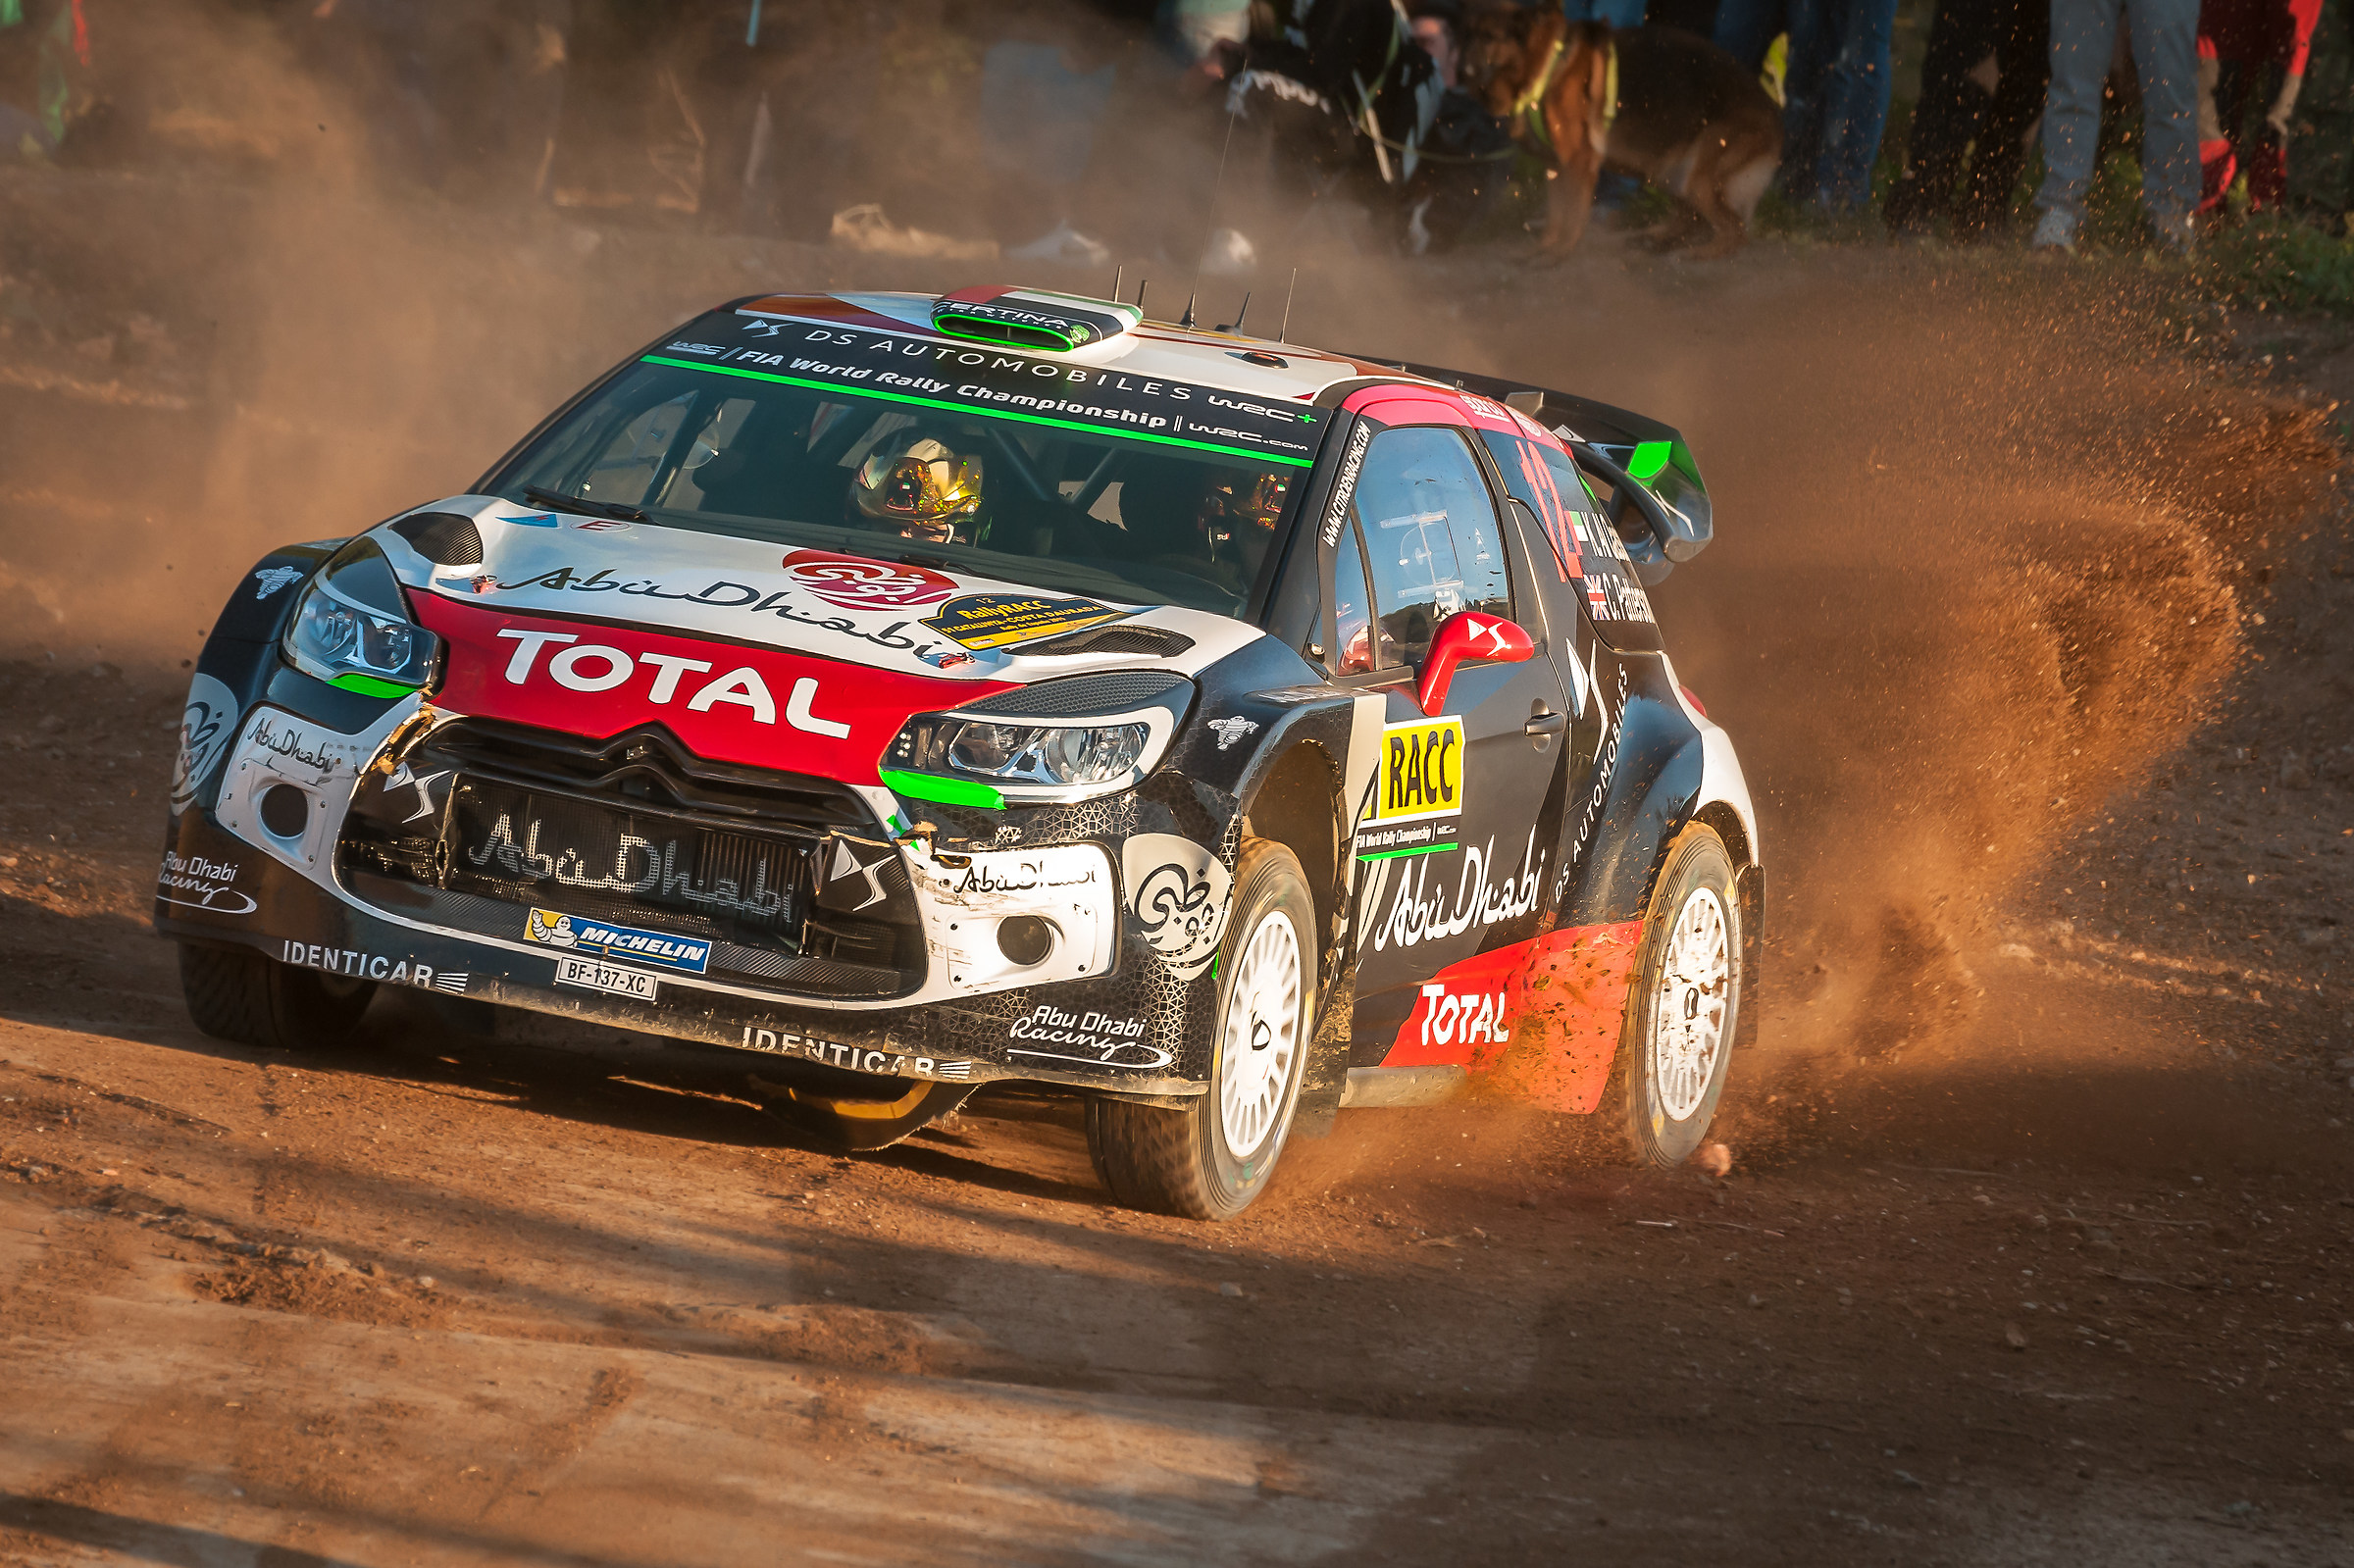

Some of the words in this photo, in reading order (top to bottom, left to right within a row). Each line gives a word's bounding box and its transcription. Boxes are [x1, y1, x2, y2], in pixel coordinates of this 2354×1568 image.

[736, 350, 784, 367] FIA
[789, 357, 873, 380] World
[875, 371, 950, 393] Rally
[957, 383, 1166, 430] Championship
[804, 329, 858, 346] DS
[870, 337, 1192, 401] AUTOMOBILES
[1322, 421, 1371, 548] WWW.CITROENRACING.COM
[496, 567, 680, 599] Abu
[685, 581, 944, 660] Dhabi
[957, 600, 1052, 621] RallyRACC
[496, 629, 851, 740] TOTAL
[1389, 729, 1455, 810] RACC
[1555, 861, 1569, 903] DS
[1572, 662, 1628, 863] AUTOMOBILES
[166, 851, 187, 872] Abu
[188, 857, 238, 882] Dhabi
[1375, 852, 1448, 951] Abu
[1452, 824, 1546, 933] Dhabi
[282, 939, 434, 987] IDENTICAR
[580, 927, 706, 961] MICHELIN
[567, 962, 646, 993] BF-137-XC
[1007, 1016, 1136, 1061] Racing
[1032, 1006, 1078, 1030] Abu
[1080, 1011, 1148, 1038] Dhabi
[1421, 984, 1509, 1045] TOTAL
